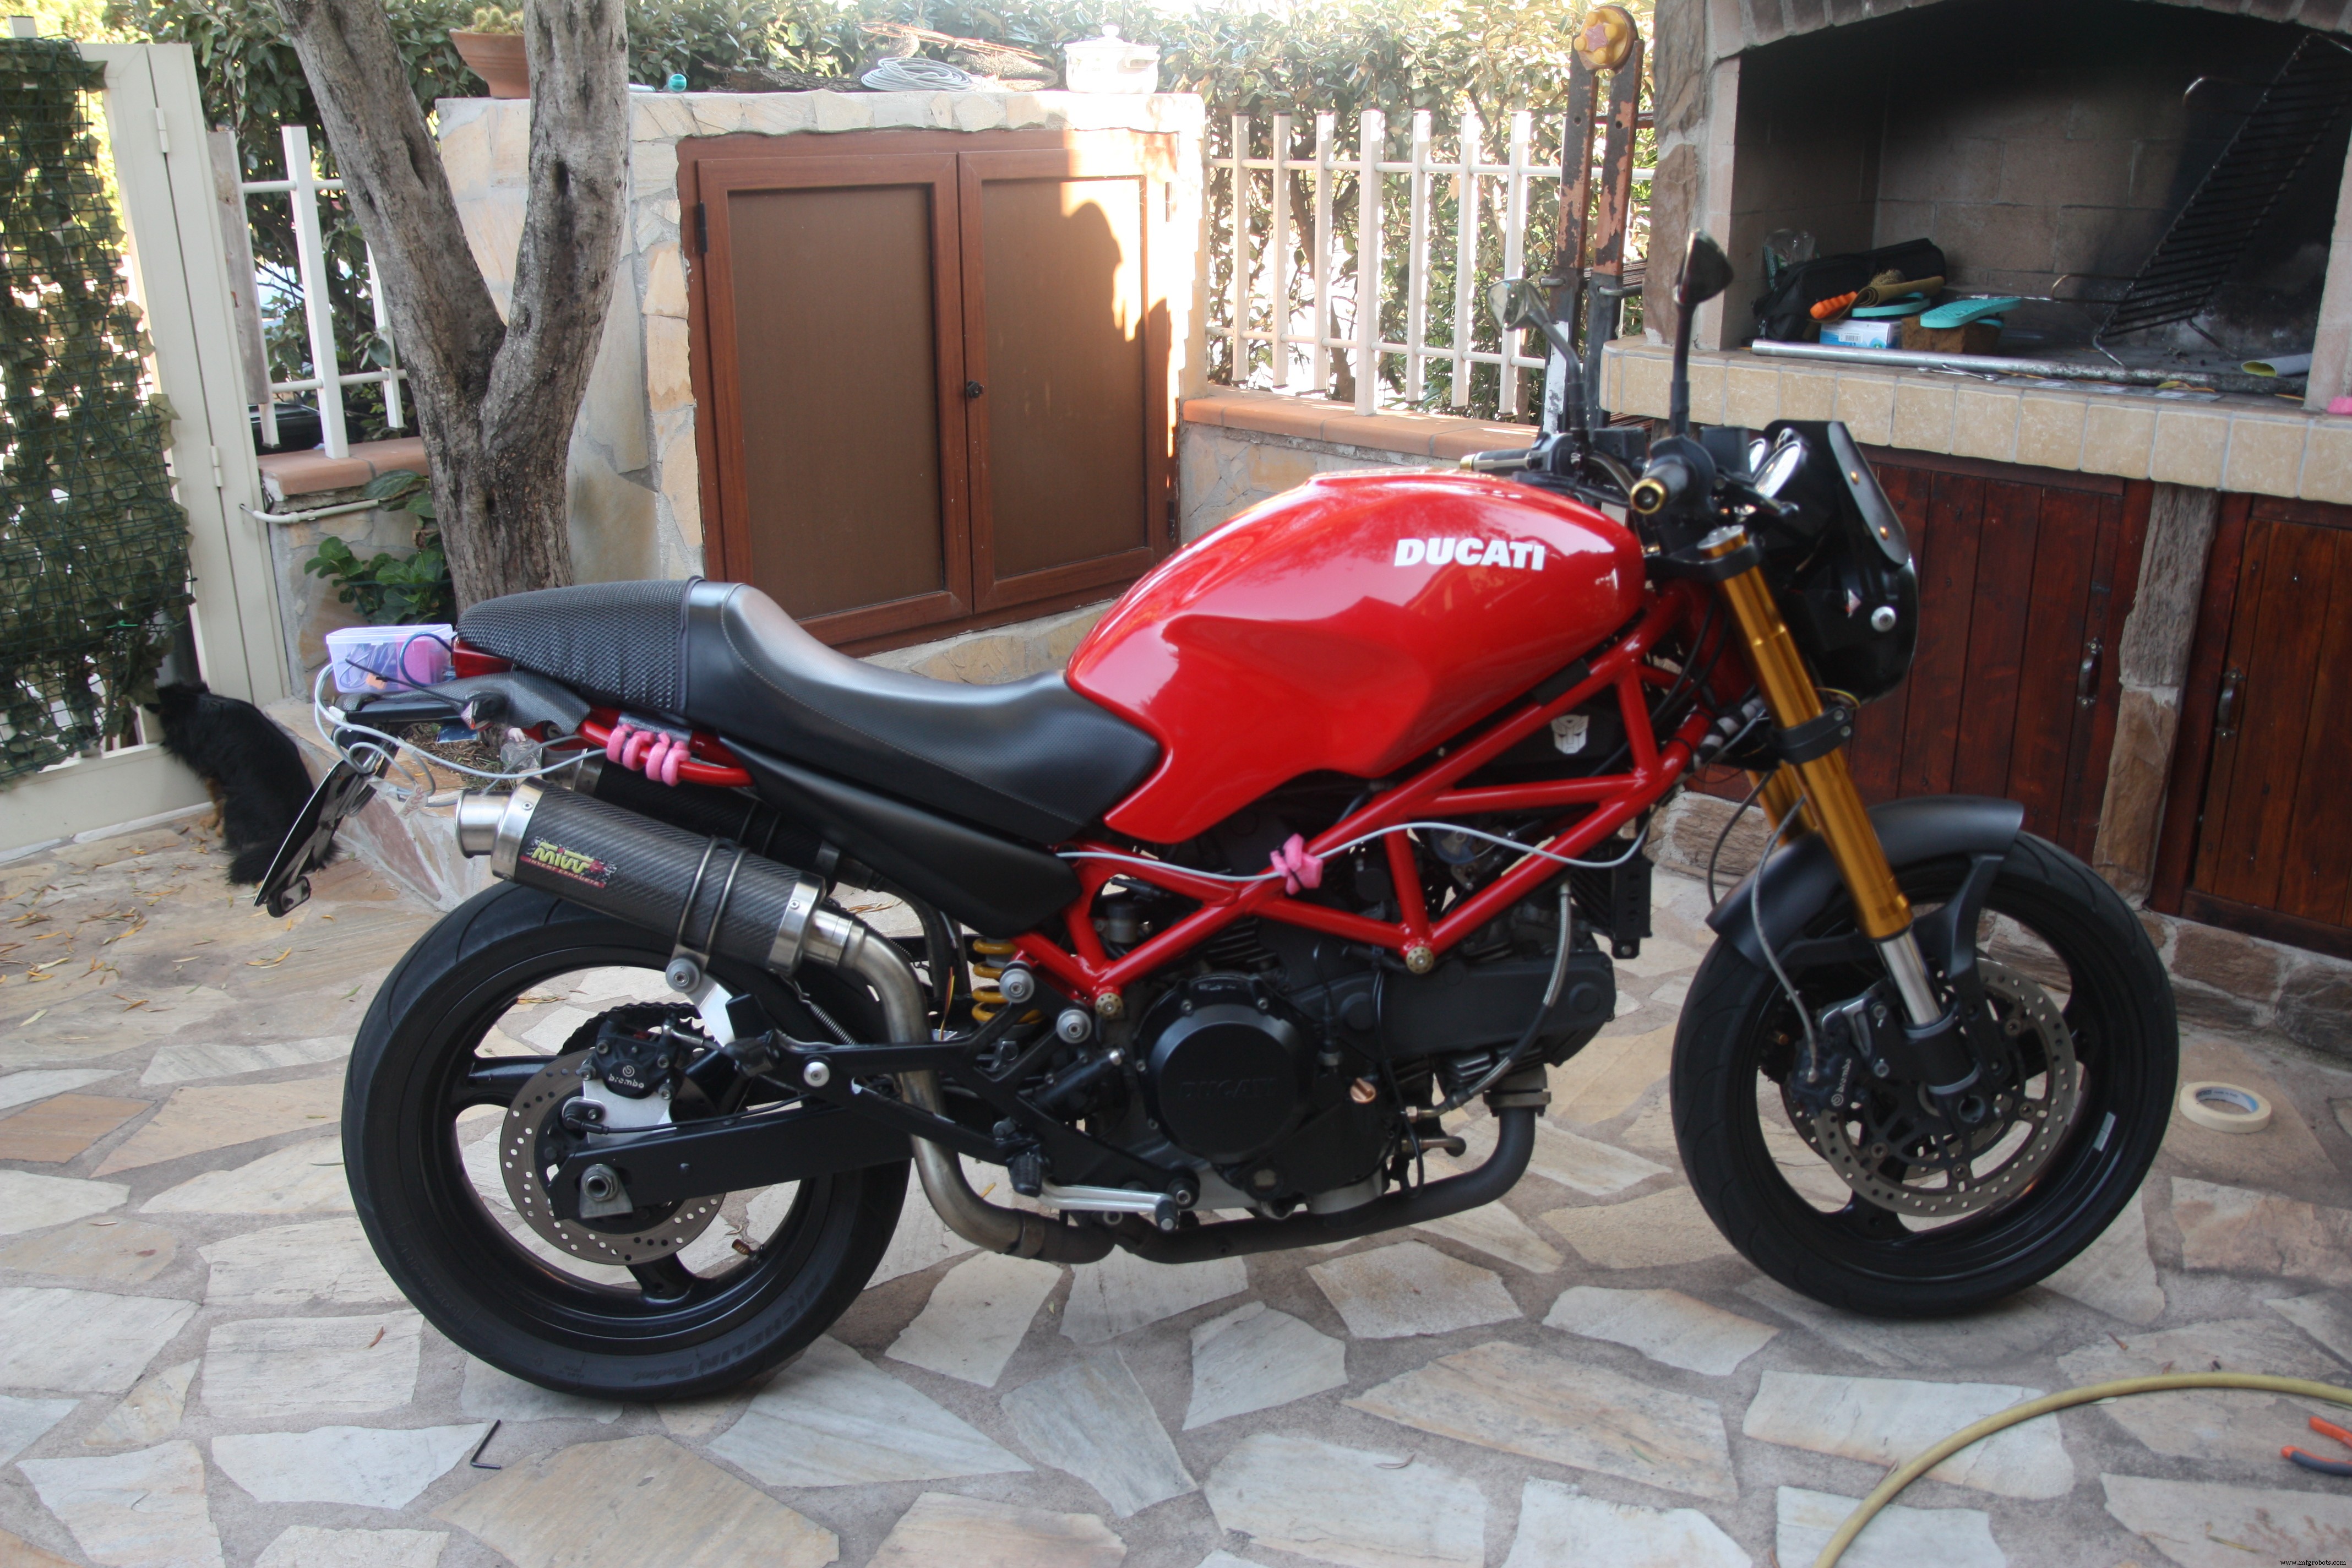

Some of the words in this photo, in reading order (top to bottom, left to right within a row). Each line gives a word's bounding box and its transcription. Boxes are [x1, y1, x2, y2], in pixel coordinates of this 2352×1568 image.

[1393, 537, 1545, 571] DUCATI
[608, 1074, 645, 1088] brembo
[1180, 1077, 1278, 1098] DUCATI
[1836, 1058, 1852, 1093] brembo
[698, 1273, 824, 1375] MICHELIN
